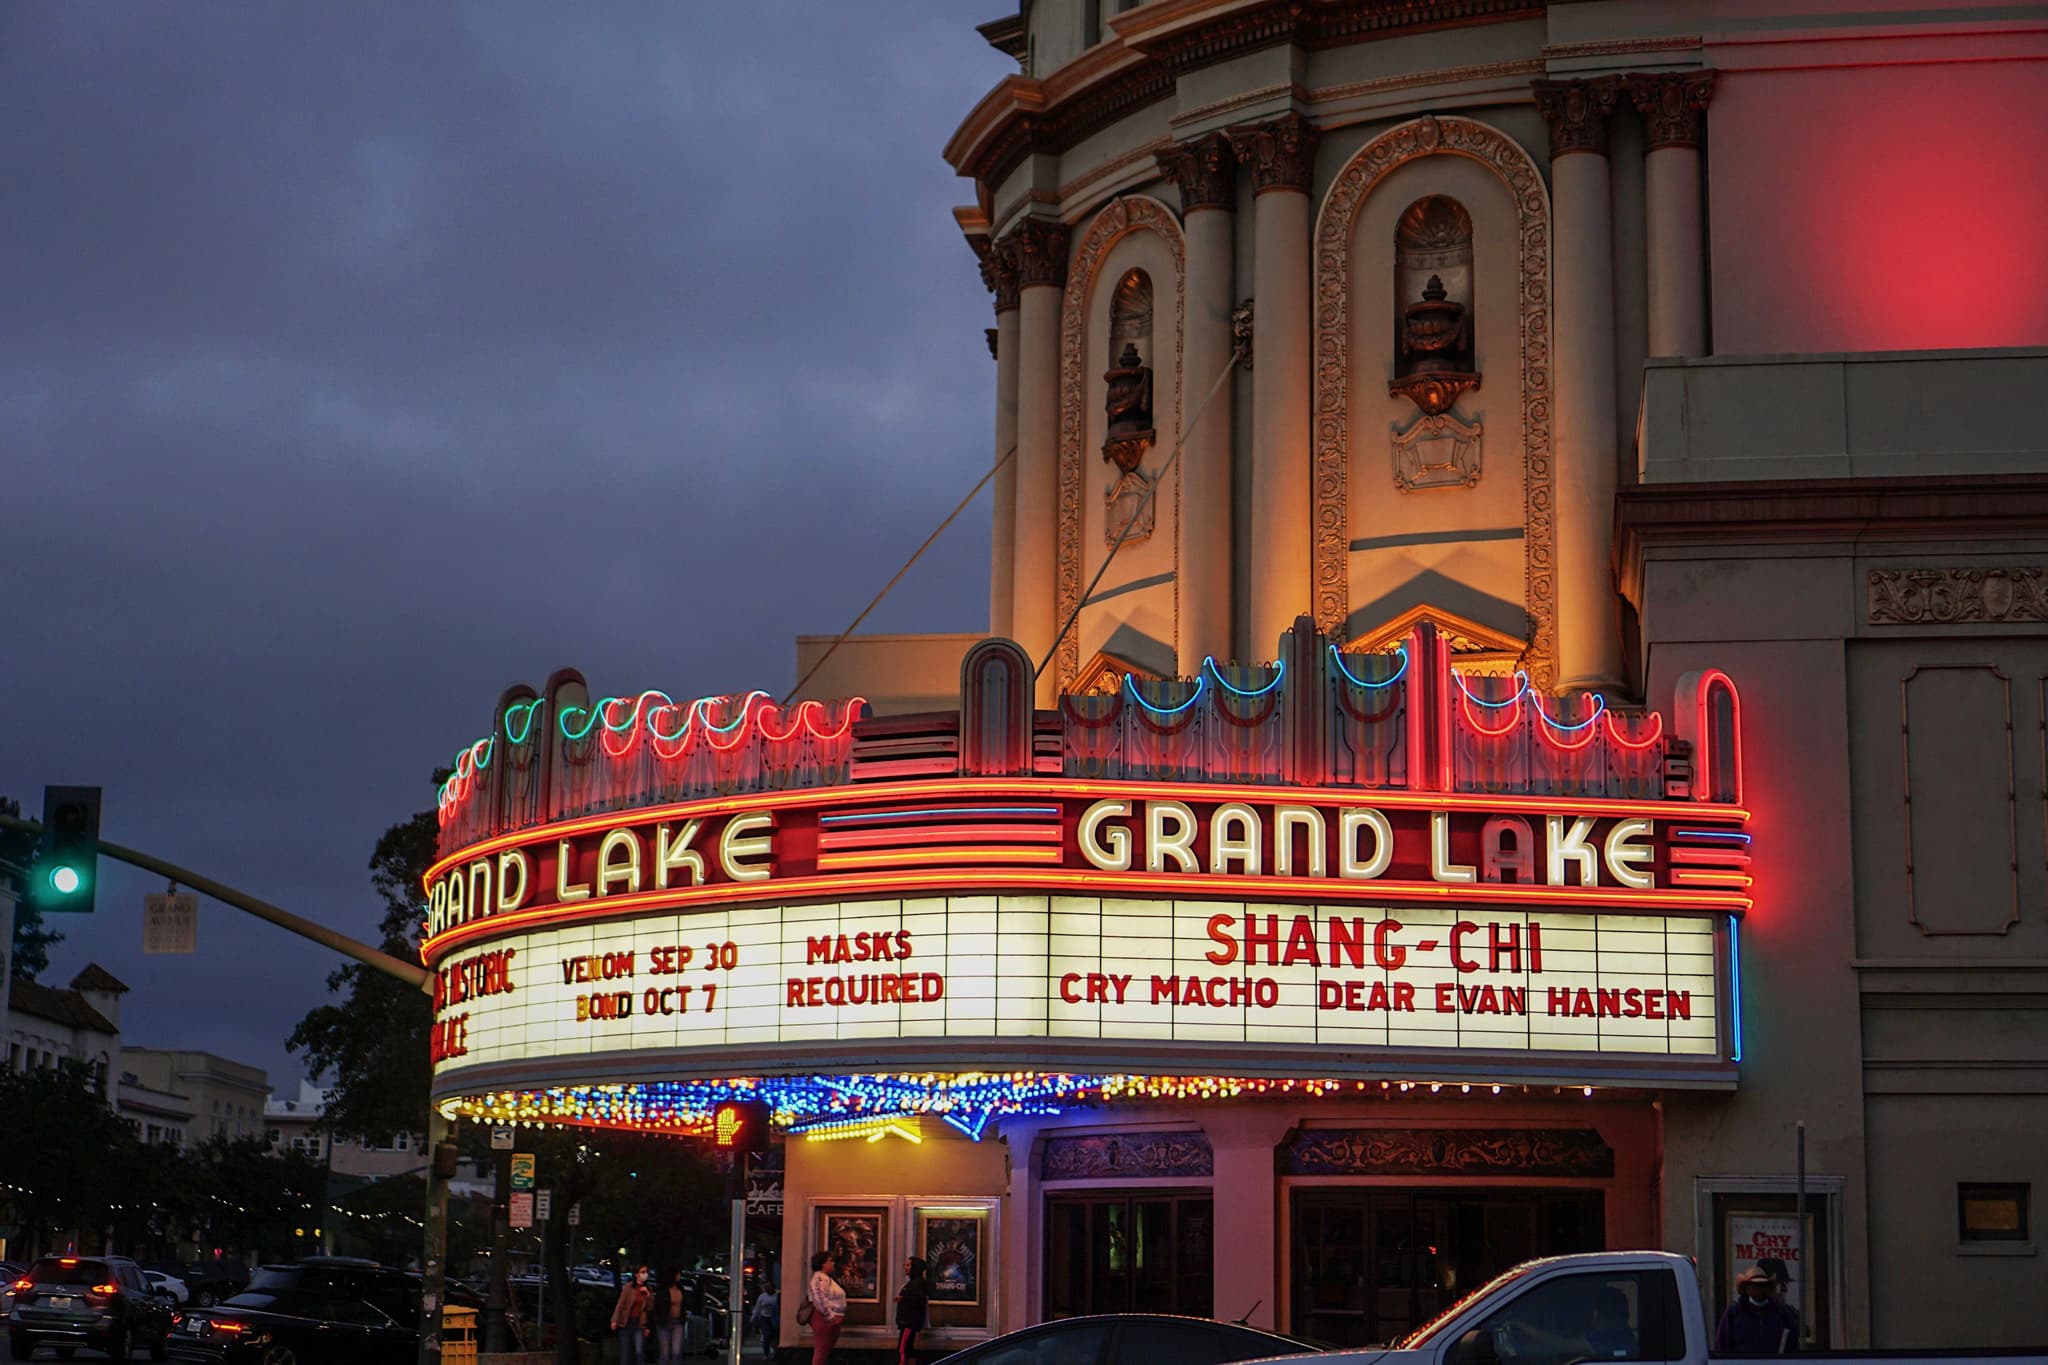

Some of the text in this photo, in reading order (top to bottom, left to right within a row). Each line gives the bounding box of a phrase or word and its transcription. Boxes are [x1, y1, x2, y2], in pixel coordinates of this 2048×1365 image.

[1077, 798, 1655, 889] GRAND LAKE
[428, 810, 773, 939] GRAND LAKE
[562, 941, 738, 985] VENOM SEP 30
[806, 930, 913, 966] MASKS
[1204, 913, 1543, 974] SHANG-CHI
[576, 983, 717, 1023] BOND OCT 7
[786, 972, 945, 1008] REQUIRED
[1060, 972, 1692, 1021] CRY MACHO DEAR EVAN HANSEN
[1752, 1231, 1792, 1248] CRY
